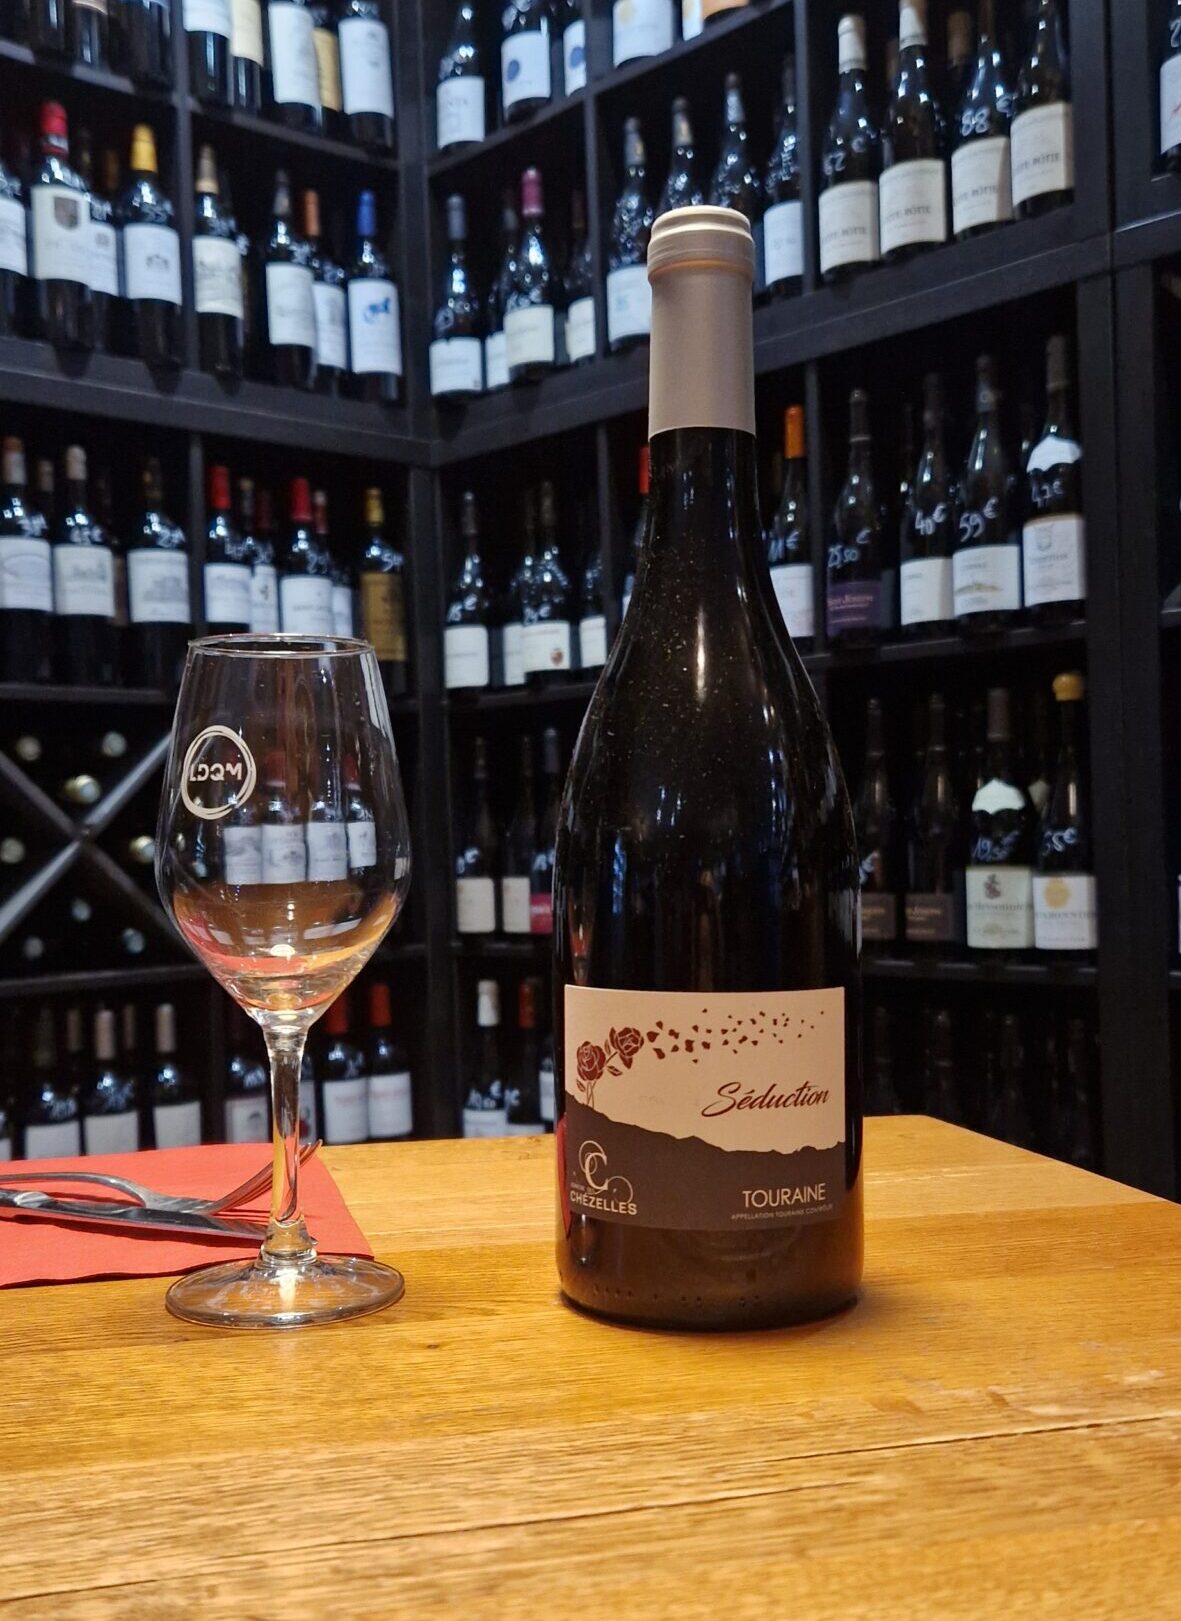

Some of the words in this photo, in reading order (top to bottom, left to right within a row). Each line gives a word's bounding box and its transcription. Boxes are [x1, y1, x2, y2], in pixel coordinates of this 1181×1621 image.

[915, 503, 947, 536] 40€
[960, 497, 999, 542] 59€
[701, 1080, 830, 1118] Séduction
[569, 1190, 638, 1216] CHÉZELLES
[742, 1183, 827, 1208] TOURAINE
[731, 1211, 774, 1220] APPELLATION
